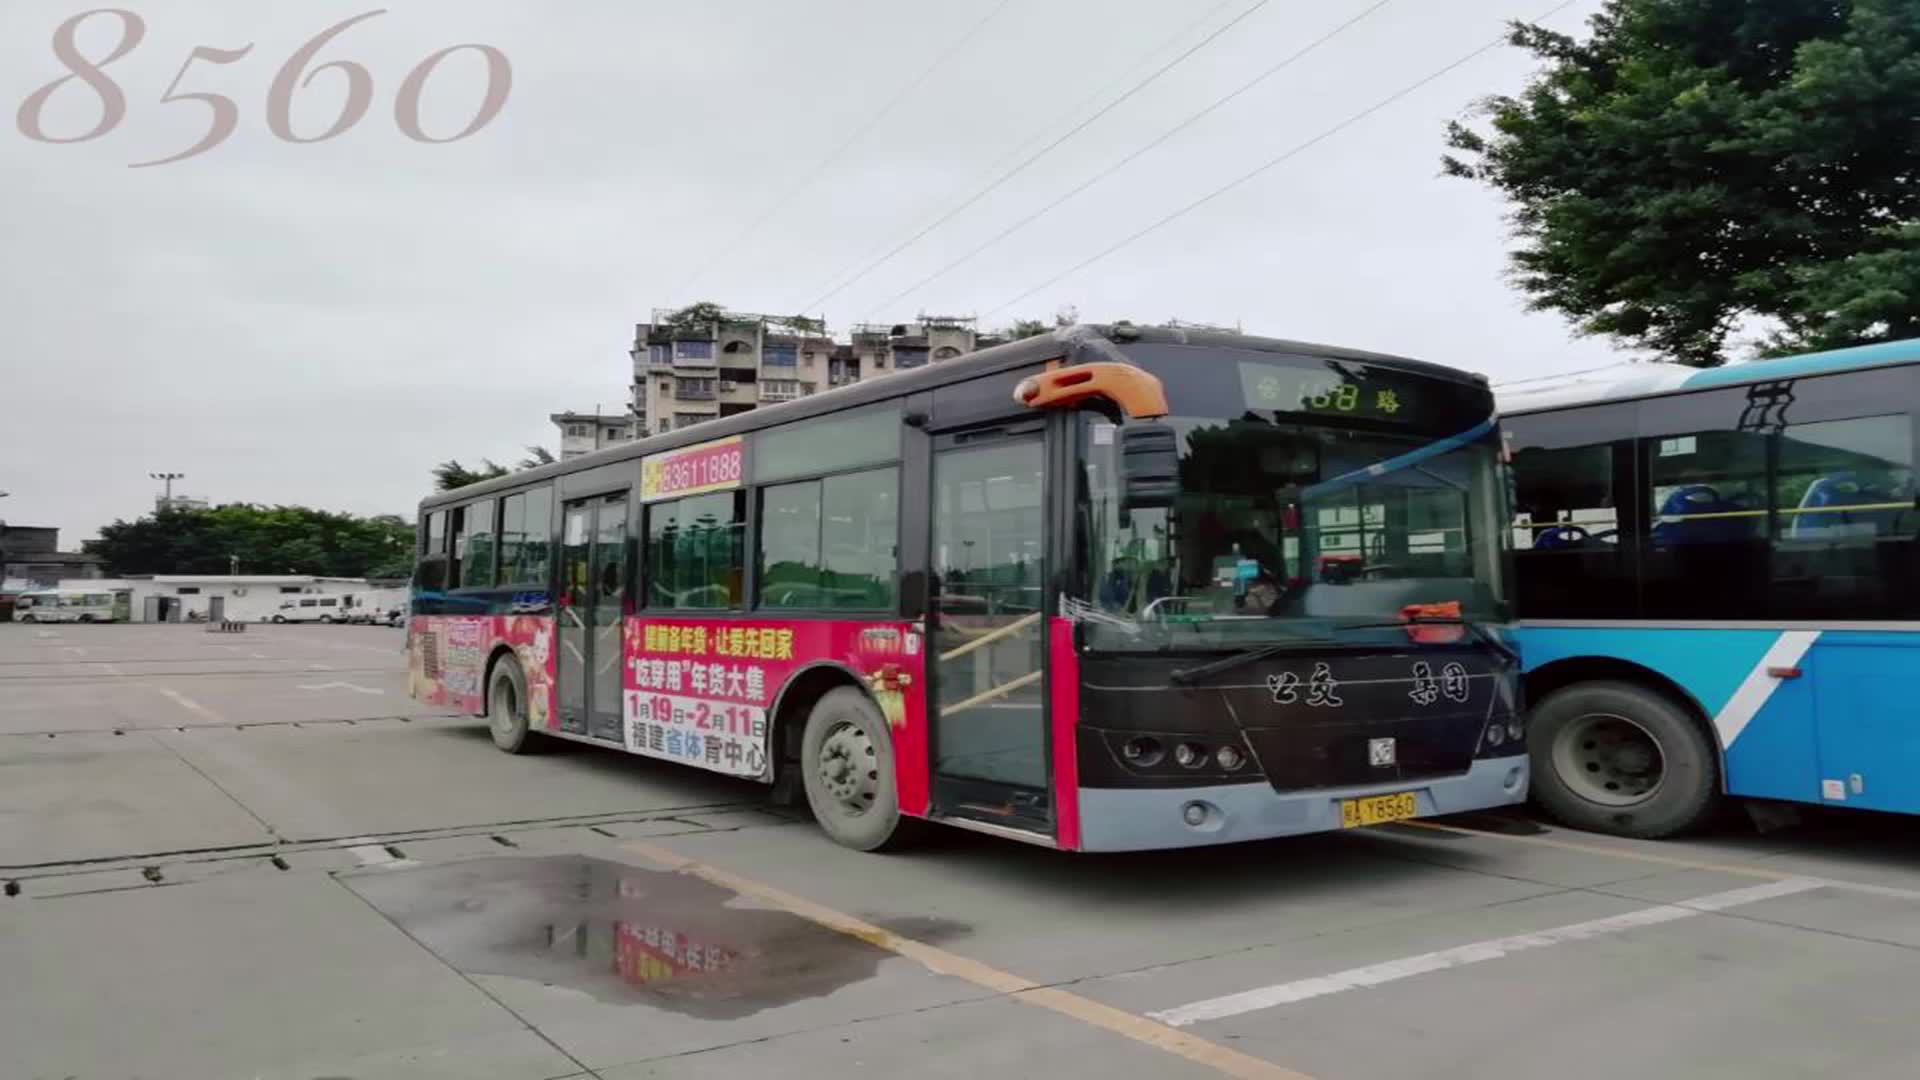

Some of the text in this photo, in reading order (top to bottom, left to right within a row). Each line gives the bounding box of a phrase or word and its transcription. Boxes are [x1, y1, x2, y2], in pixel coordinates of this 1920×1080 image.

[631, 721, 767, 772] 福建省体育中心
